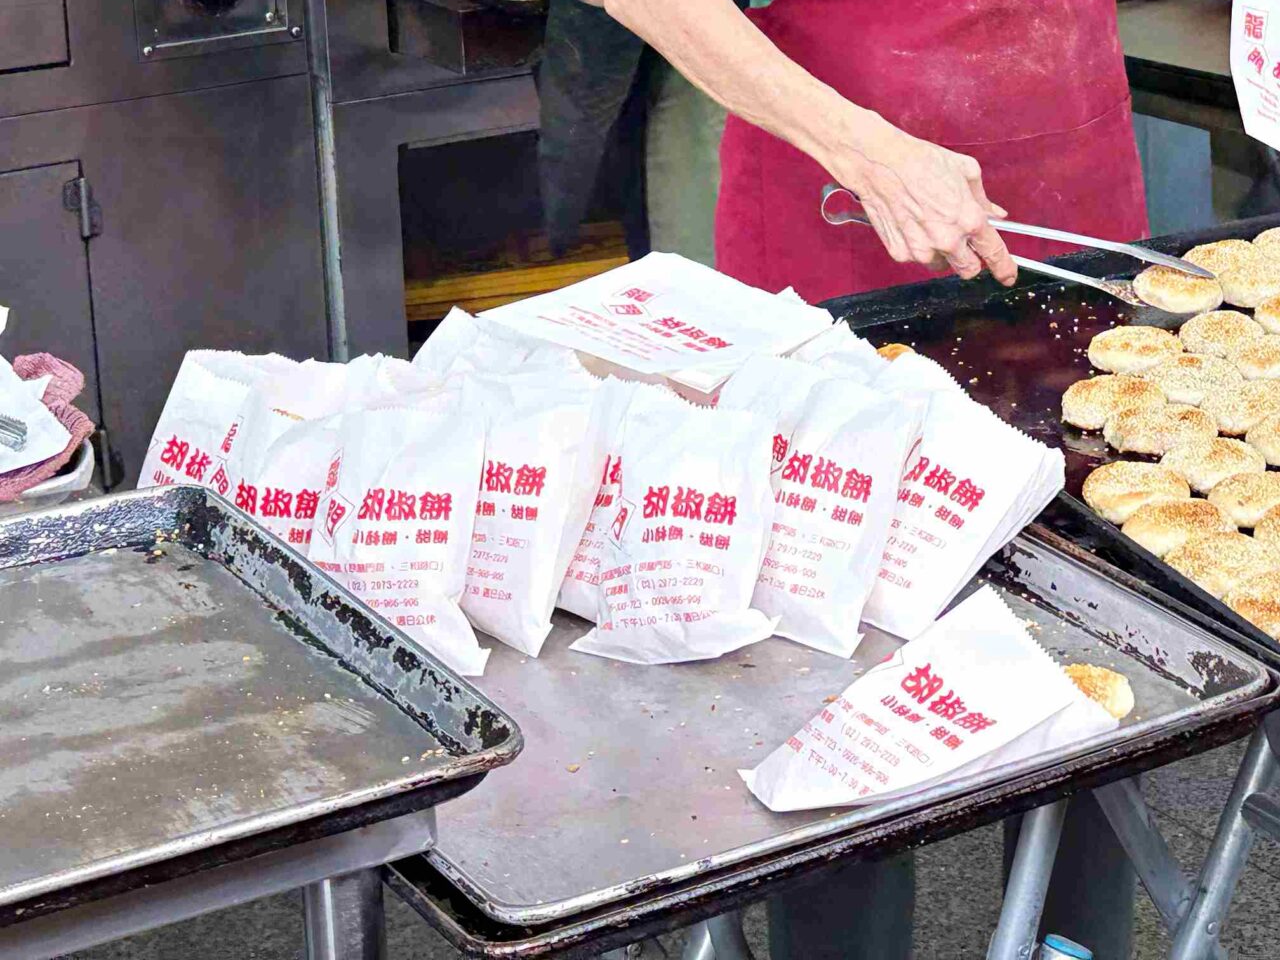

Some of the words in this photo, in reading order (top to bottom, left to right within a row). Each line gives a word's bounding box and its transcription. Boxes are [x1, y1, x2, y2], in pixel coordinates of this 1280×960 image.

[781, 451, 873, 504] 胡椒餅
[356, 488, 453, 522] 胡椒餅
[642, 485, 738, 526] 胡椒餅
[901, 662, 998, 734] 胡椒餅
